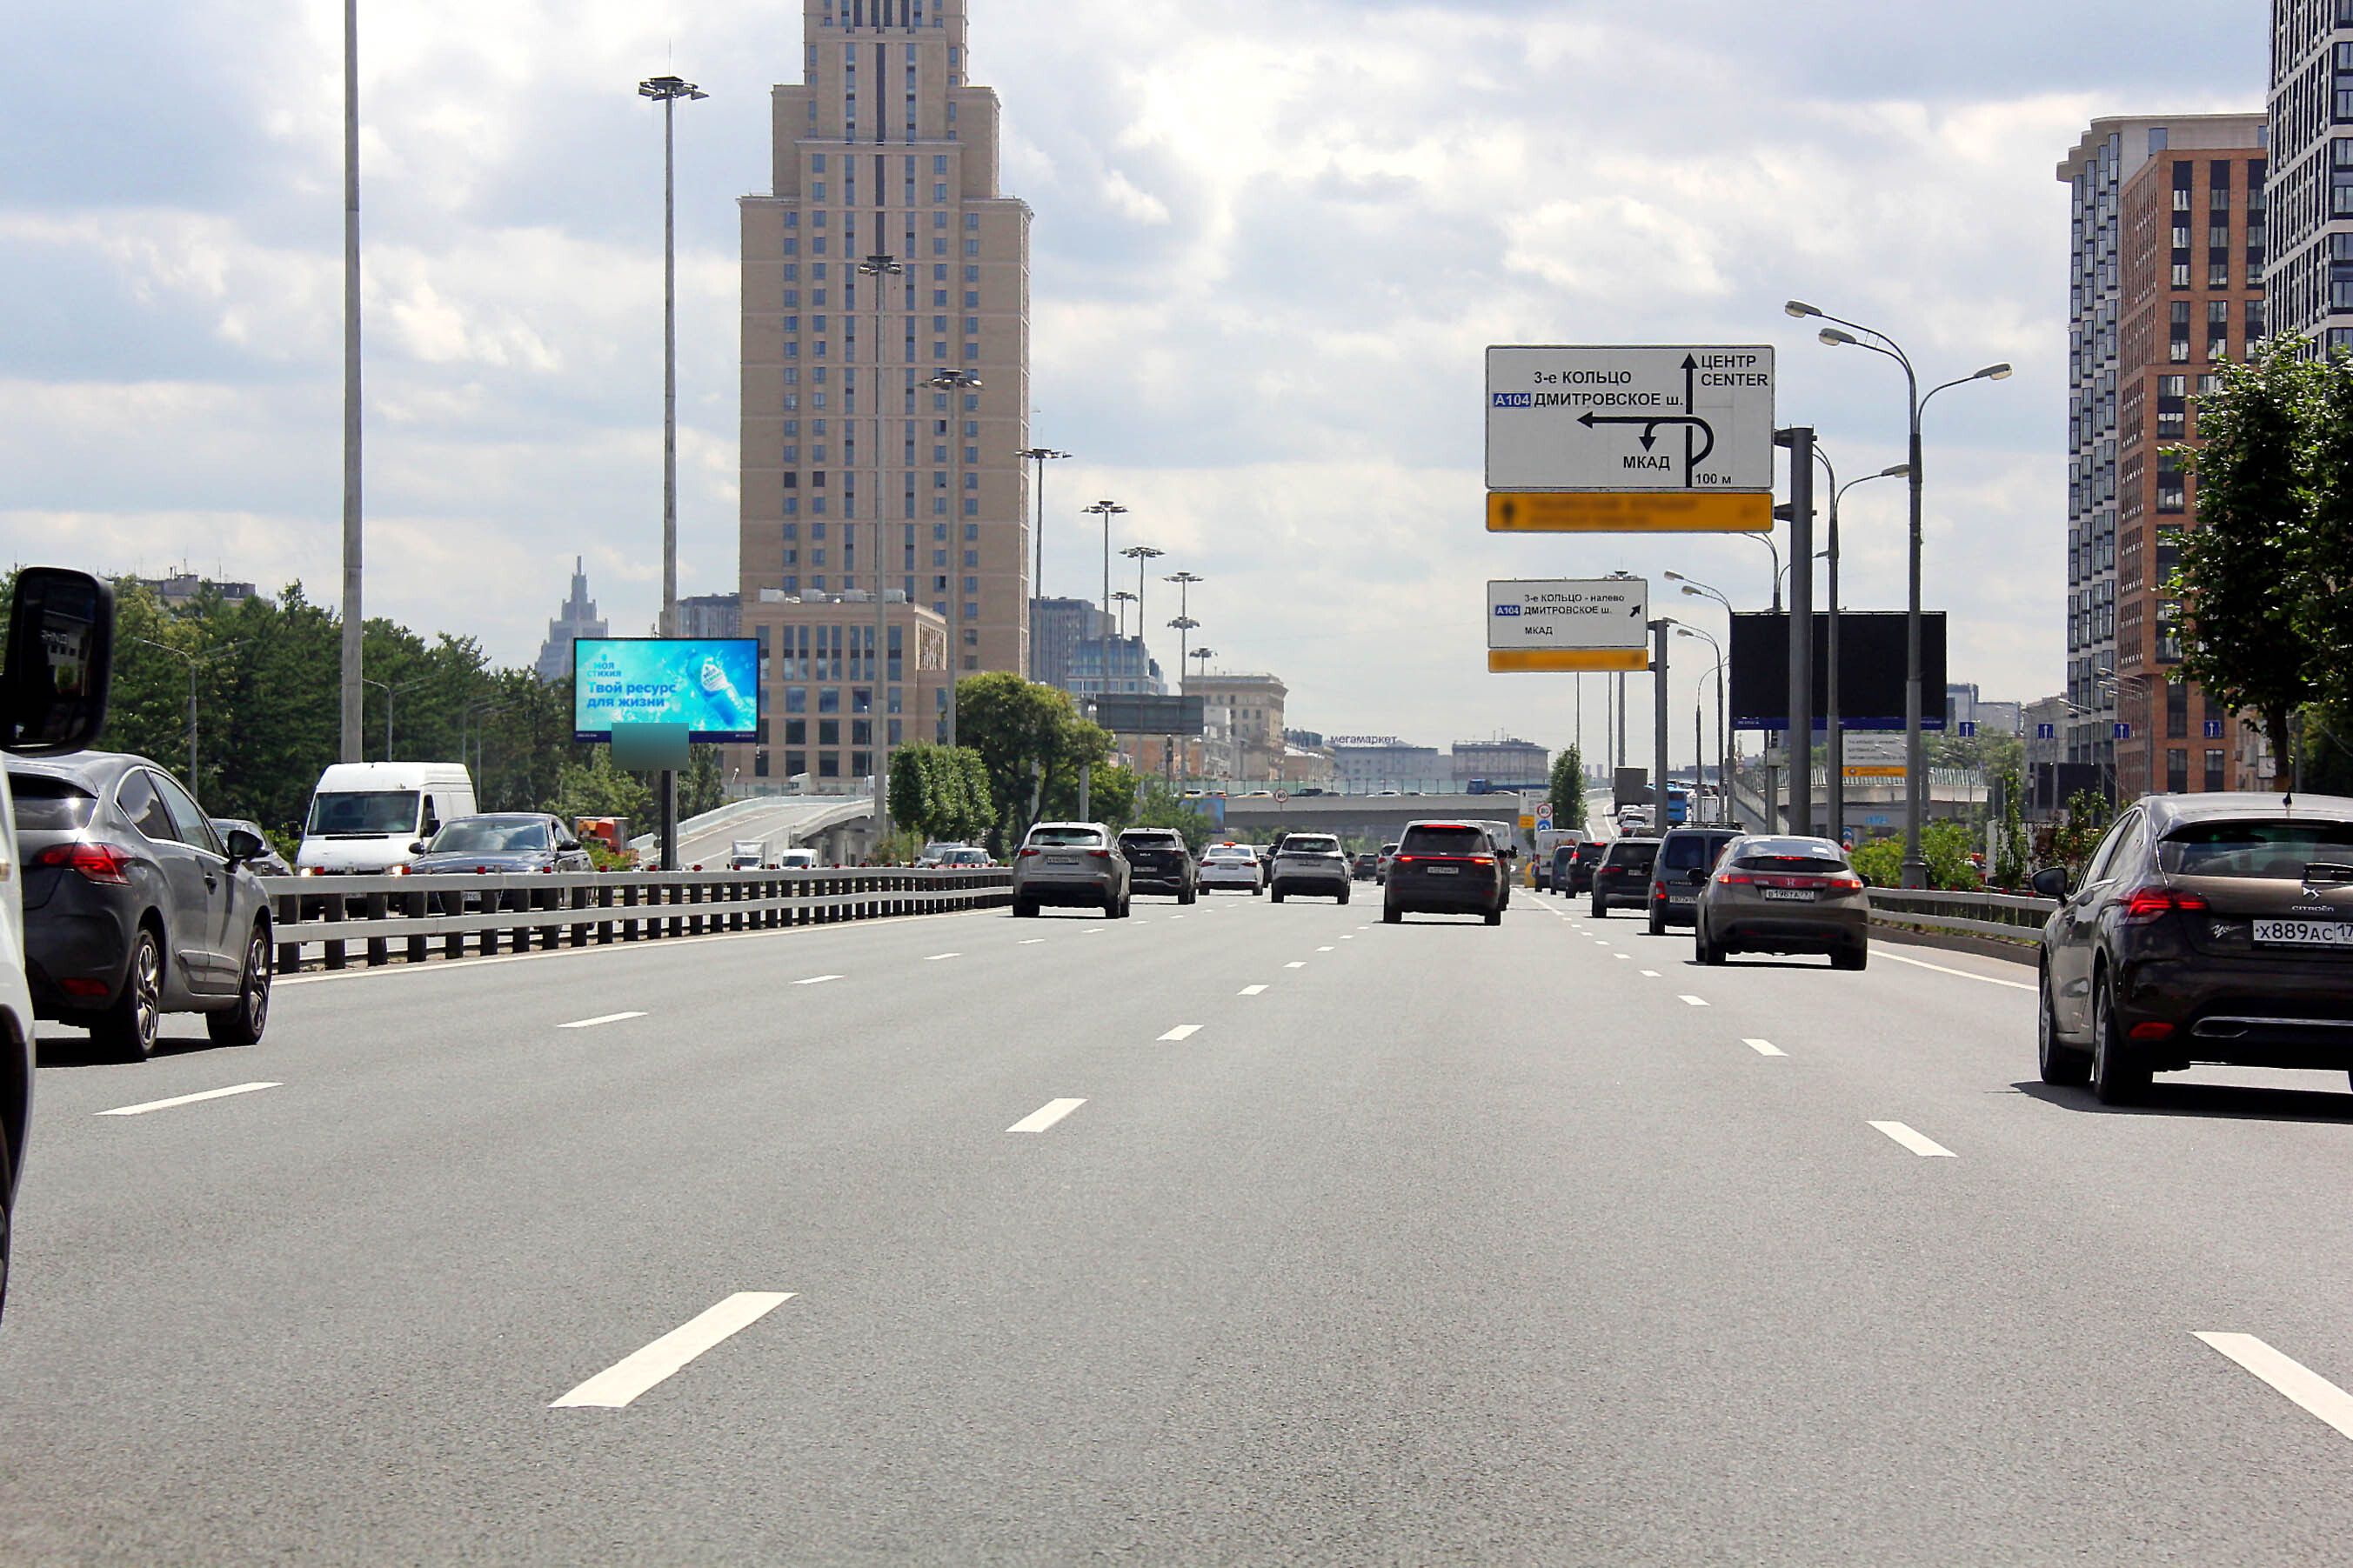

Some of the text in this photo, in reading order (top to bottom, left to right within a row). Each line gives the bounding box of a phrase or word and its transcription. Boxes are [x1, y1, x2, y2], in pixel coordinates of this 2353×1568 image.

[1701, 355, 1756, 370] ЦЕНТР
[1534, 370, 1632, 386] 3-е КОЛЬЦО
[1701, 373, 1768, 386] CENTER
[1534, 393, 1661, 407] ДМИТРОВСКОЕ
[1666, 397, 1683, 405] ш.
[1623, 456, 1670, 470] МКАД
[1695, 473, 1717, 484] 100
[1524, 594, 1539, 603] 3-е
[1541, 594, 1582, 604] КОЛЬЦО
[1524, 606, 1598, 616] ДМИТРОВСКОЕ
[1525, 627, 1553, 636] МКАД
[587, 681, 676, 695] Твой ресурс
[586, 698, 665, 709] для жизни
[1330, 735, 1398, 745] мегамаркет
